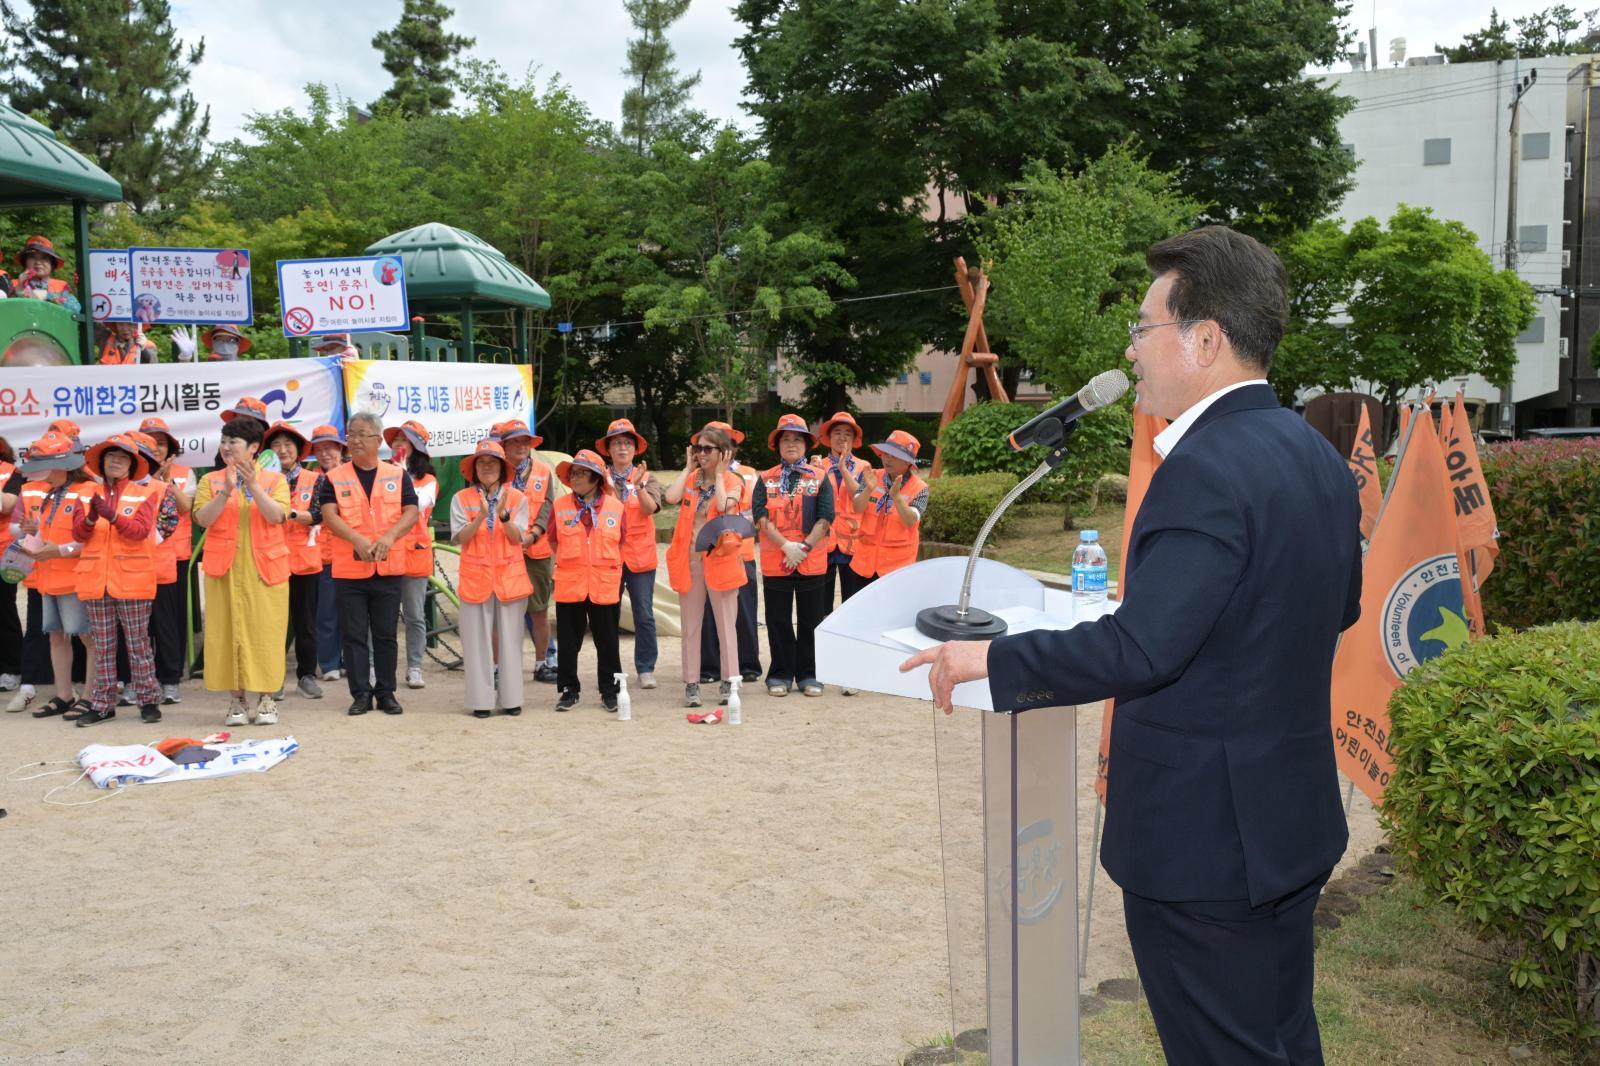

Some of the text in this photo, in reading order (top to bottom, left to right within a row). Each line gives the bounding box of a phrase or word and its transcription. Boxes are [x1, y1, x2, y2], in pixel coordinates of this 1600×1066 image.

[139, 254, 194, 266] 반려동물은
[302, 268, 324, 279] 놀이
[454, 385, 492, 412] 시설소독
[494, 385, 510, 411] 활동
[1391, 592, 1413, 664] Volunteers of
